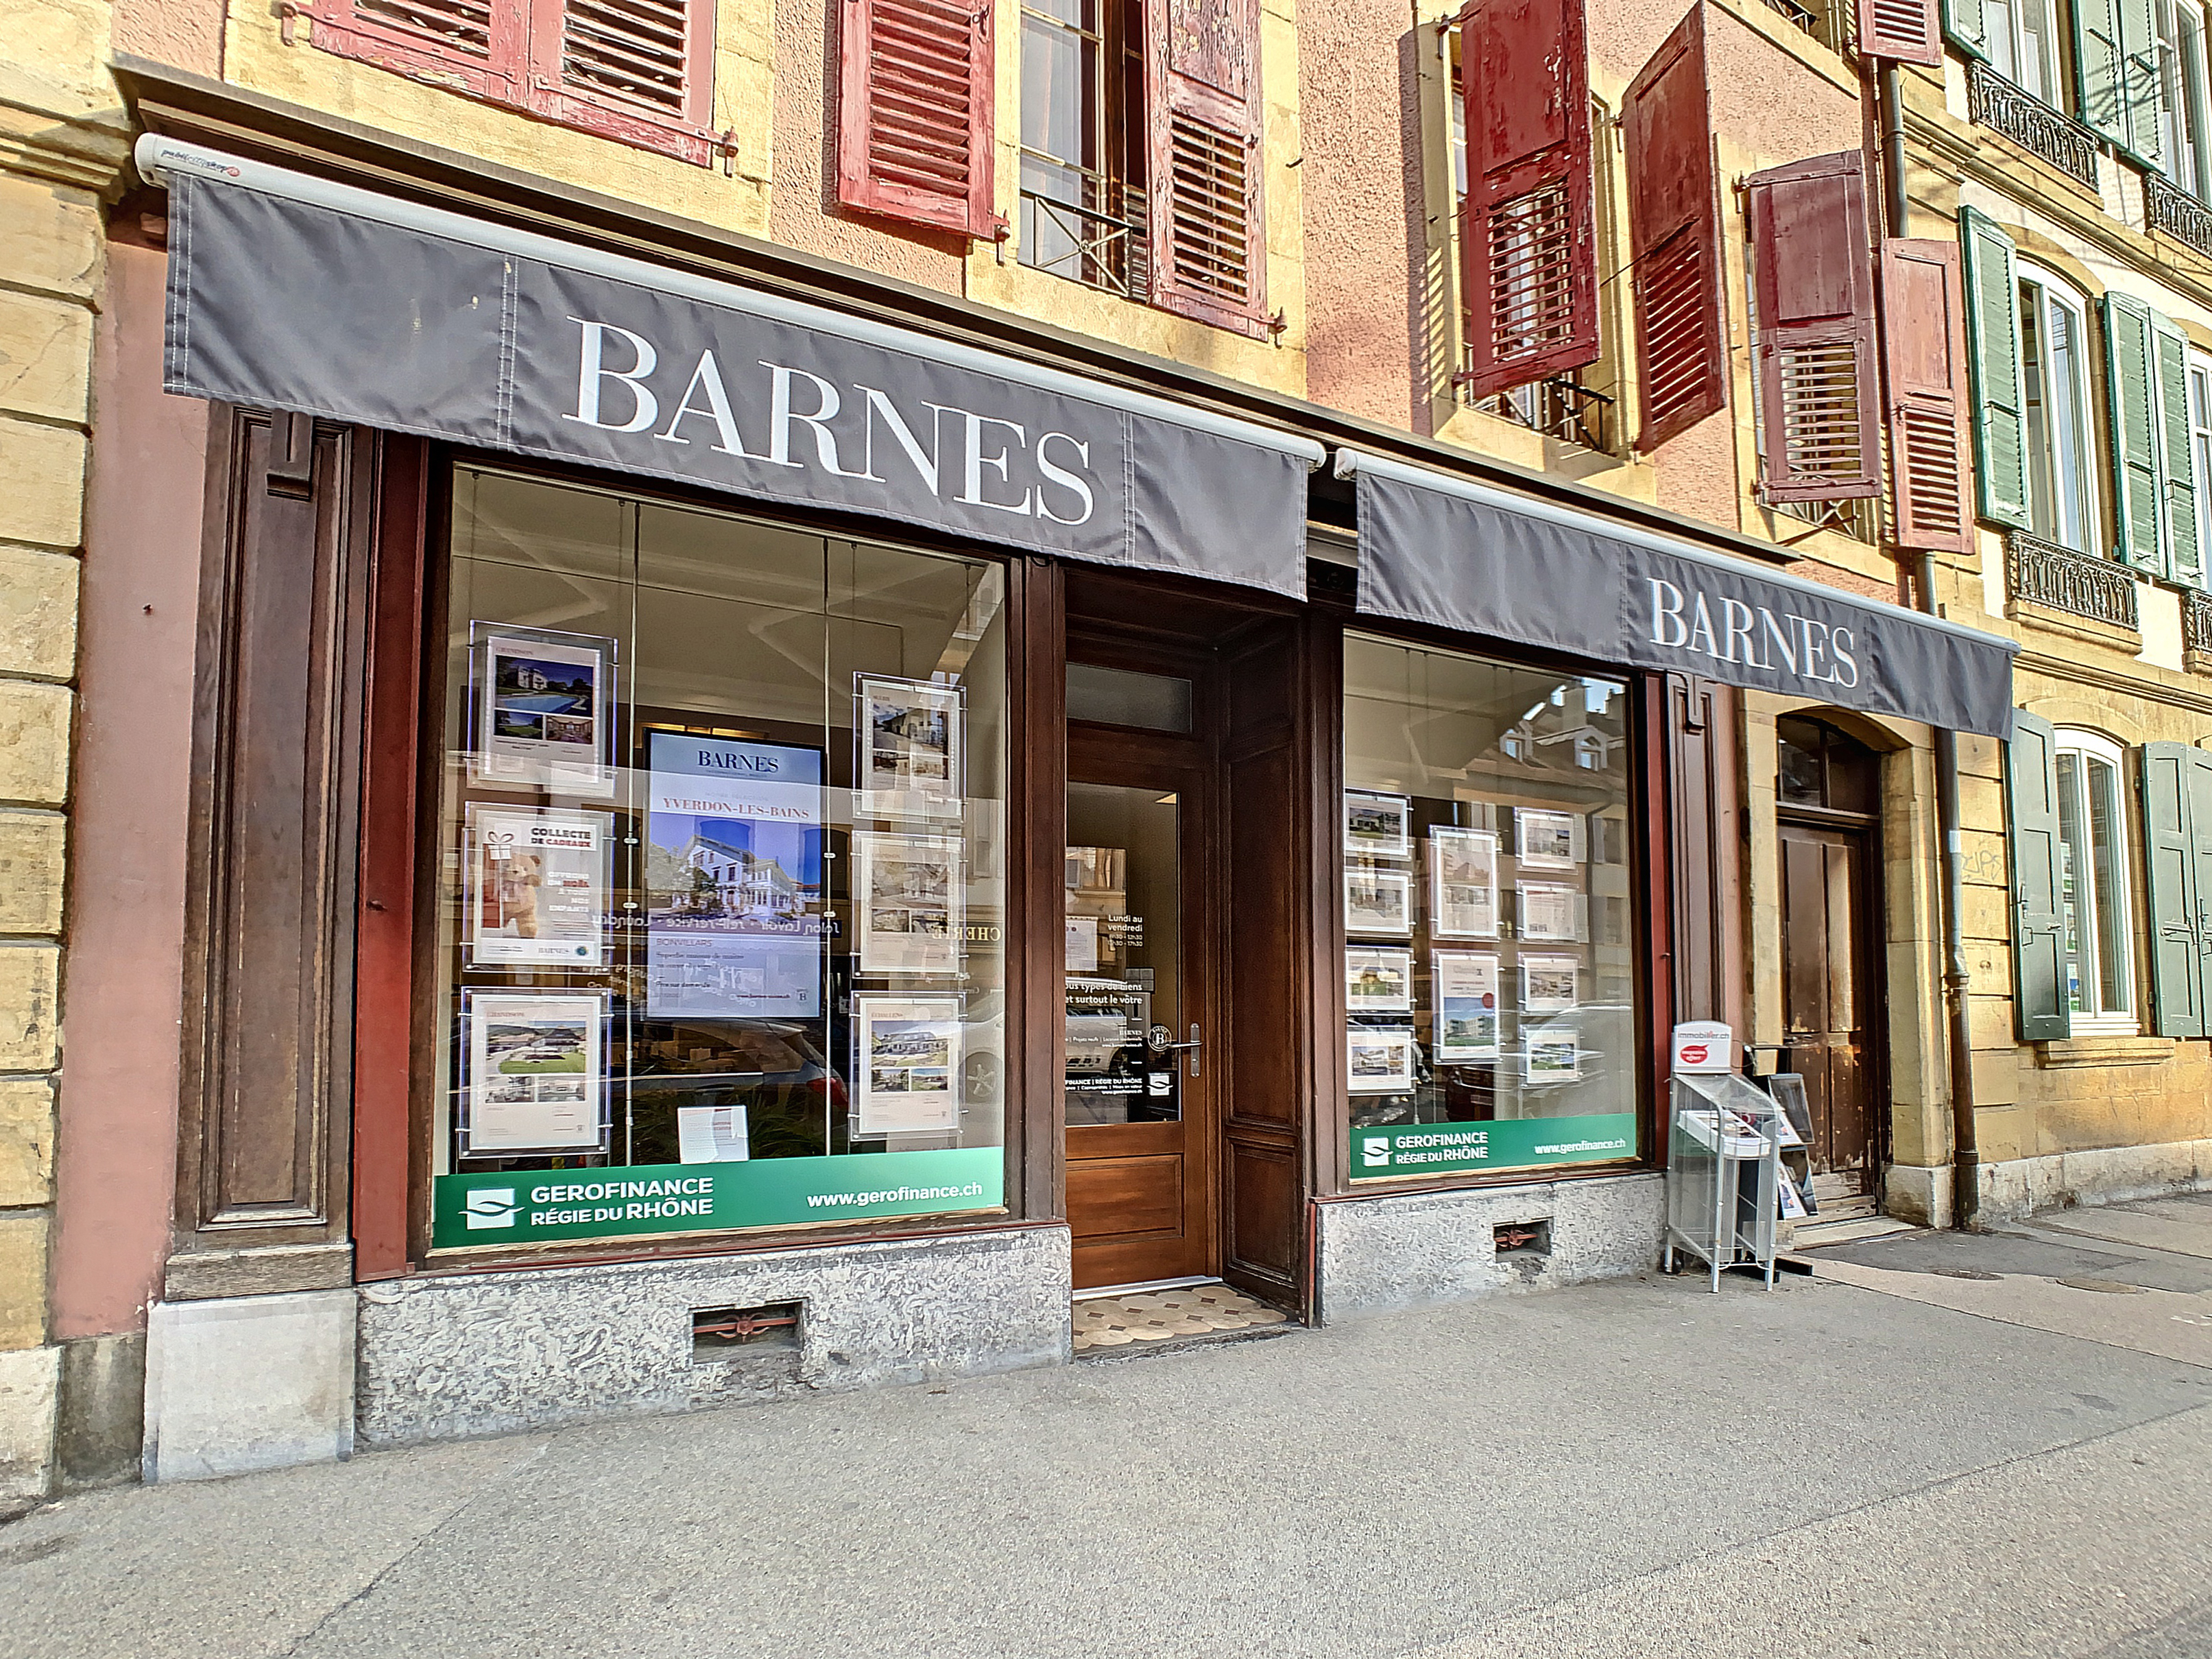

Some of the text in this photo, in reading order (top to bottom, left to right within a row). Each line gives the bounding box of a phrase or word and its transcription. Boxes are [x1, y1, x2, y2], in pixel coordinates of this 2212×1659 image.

[562, 315, 1095, 526] BARNES
[1646, 577, 1858, 688] BARNES
[697, 750, 779, 773] BARNES
[663, 798, 809, 819] YVERDON-LES-BAINS
[531, 827, 591, 839] COLLECTE
[1108, 914, 1131, 922] Lundi
[1107, 923, 1143, 932] vendredi
[656, 938, 713, 947] BONVILLARS
[1081, 983, 1105, 994] types
[1120, 982, 1142, 990] biens
[1076, 995, 1108, 1004] surtout
[1110, 994, 1118, 1004] le
[1155, 1033, 1165, 1045] B
[1396, 1132, 1489, 1149] GEROFINANCE
[1534, 1138, 1626, 1154] www.gerofinance.ch
[1396, 1145, 1489, 1165] RÉGIE DU RHÔNE
[531, 1177, 714, 1204] GEROFINANCE
[806, 1181, 983, 1207] www.gerofinance.ch
[531, 1197, 714, 1226] RÉGIE DU RHÔNE
